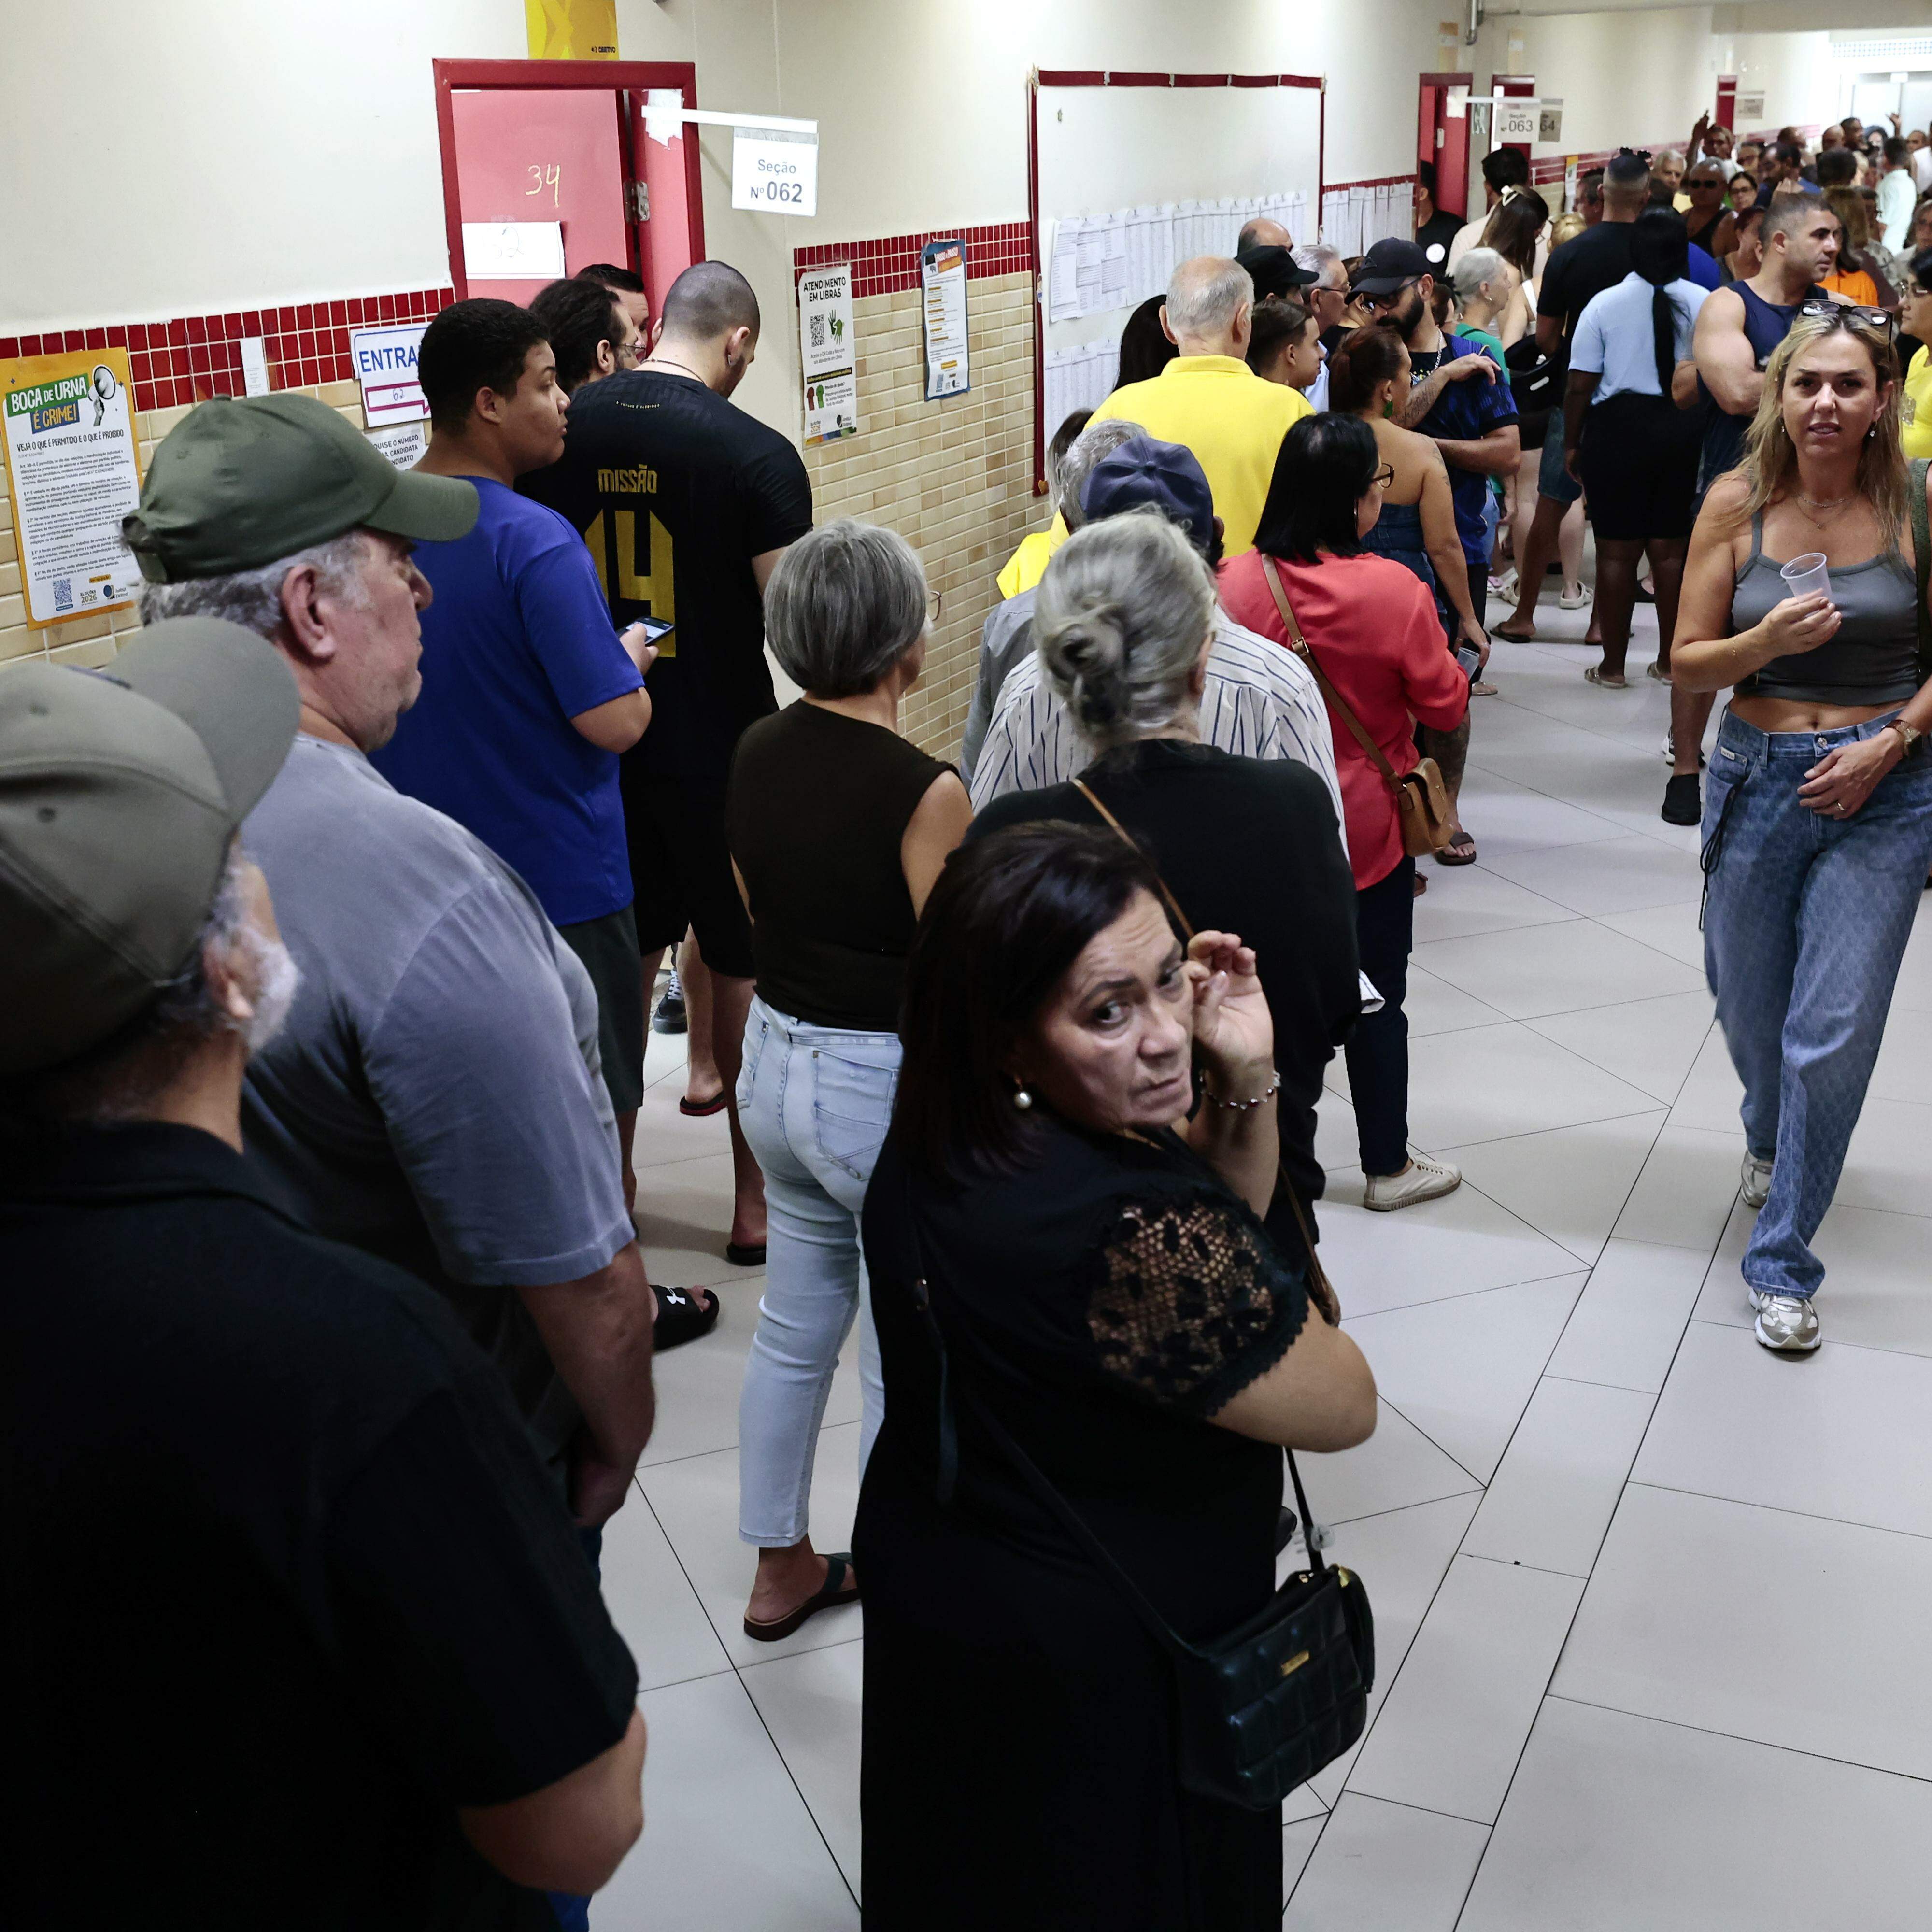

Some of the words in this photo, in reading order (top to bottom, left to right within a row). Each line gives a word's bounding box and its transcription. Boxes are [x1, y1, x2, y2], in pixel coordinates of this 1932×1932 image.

[1508, 119, 1533, 132] 063
[757, 159, 796, 176] Seção
[525, 163, 560, 208] 34
[767, 181, 802, 203] 062
[803, 277, 846, 292] ATENDIMENTO
[809, 292, 818, 302] EM
[820, 288, 841, 301] LIBRAS
[359, 345, 421, 372] ENTRA
[11, 387, 43, 412] BOCA
[54, 377, 87, 401] URNA
[33, 412, 41, 430] É
[43, 403, 77, 427] CRIME!
[17, 443, 31, 452] VEJA
[32, 441, 37, 450] O
[37, 440, 47, 450] QUE
[48, 438, 52, 447] É
[52, 436, 77, 447] PERMITIDO
[88, 433, 98, 443] QUE
[99, 431, 102, 440] É
[102, 429, 124, 440] PROIBIDO
[390, 444, 418, 457] CANDIDATA
[398, 434, 418, 445] NÚMERO
[597, 464, 657, 493] MISSÃO
[584, 509, 676, 657] 14
[81, 594, 97, 604] 2026
